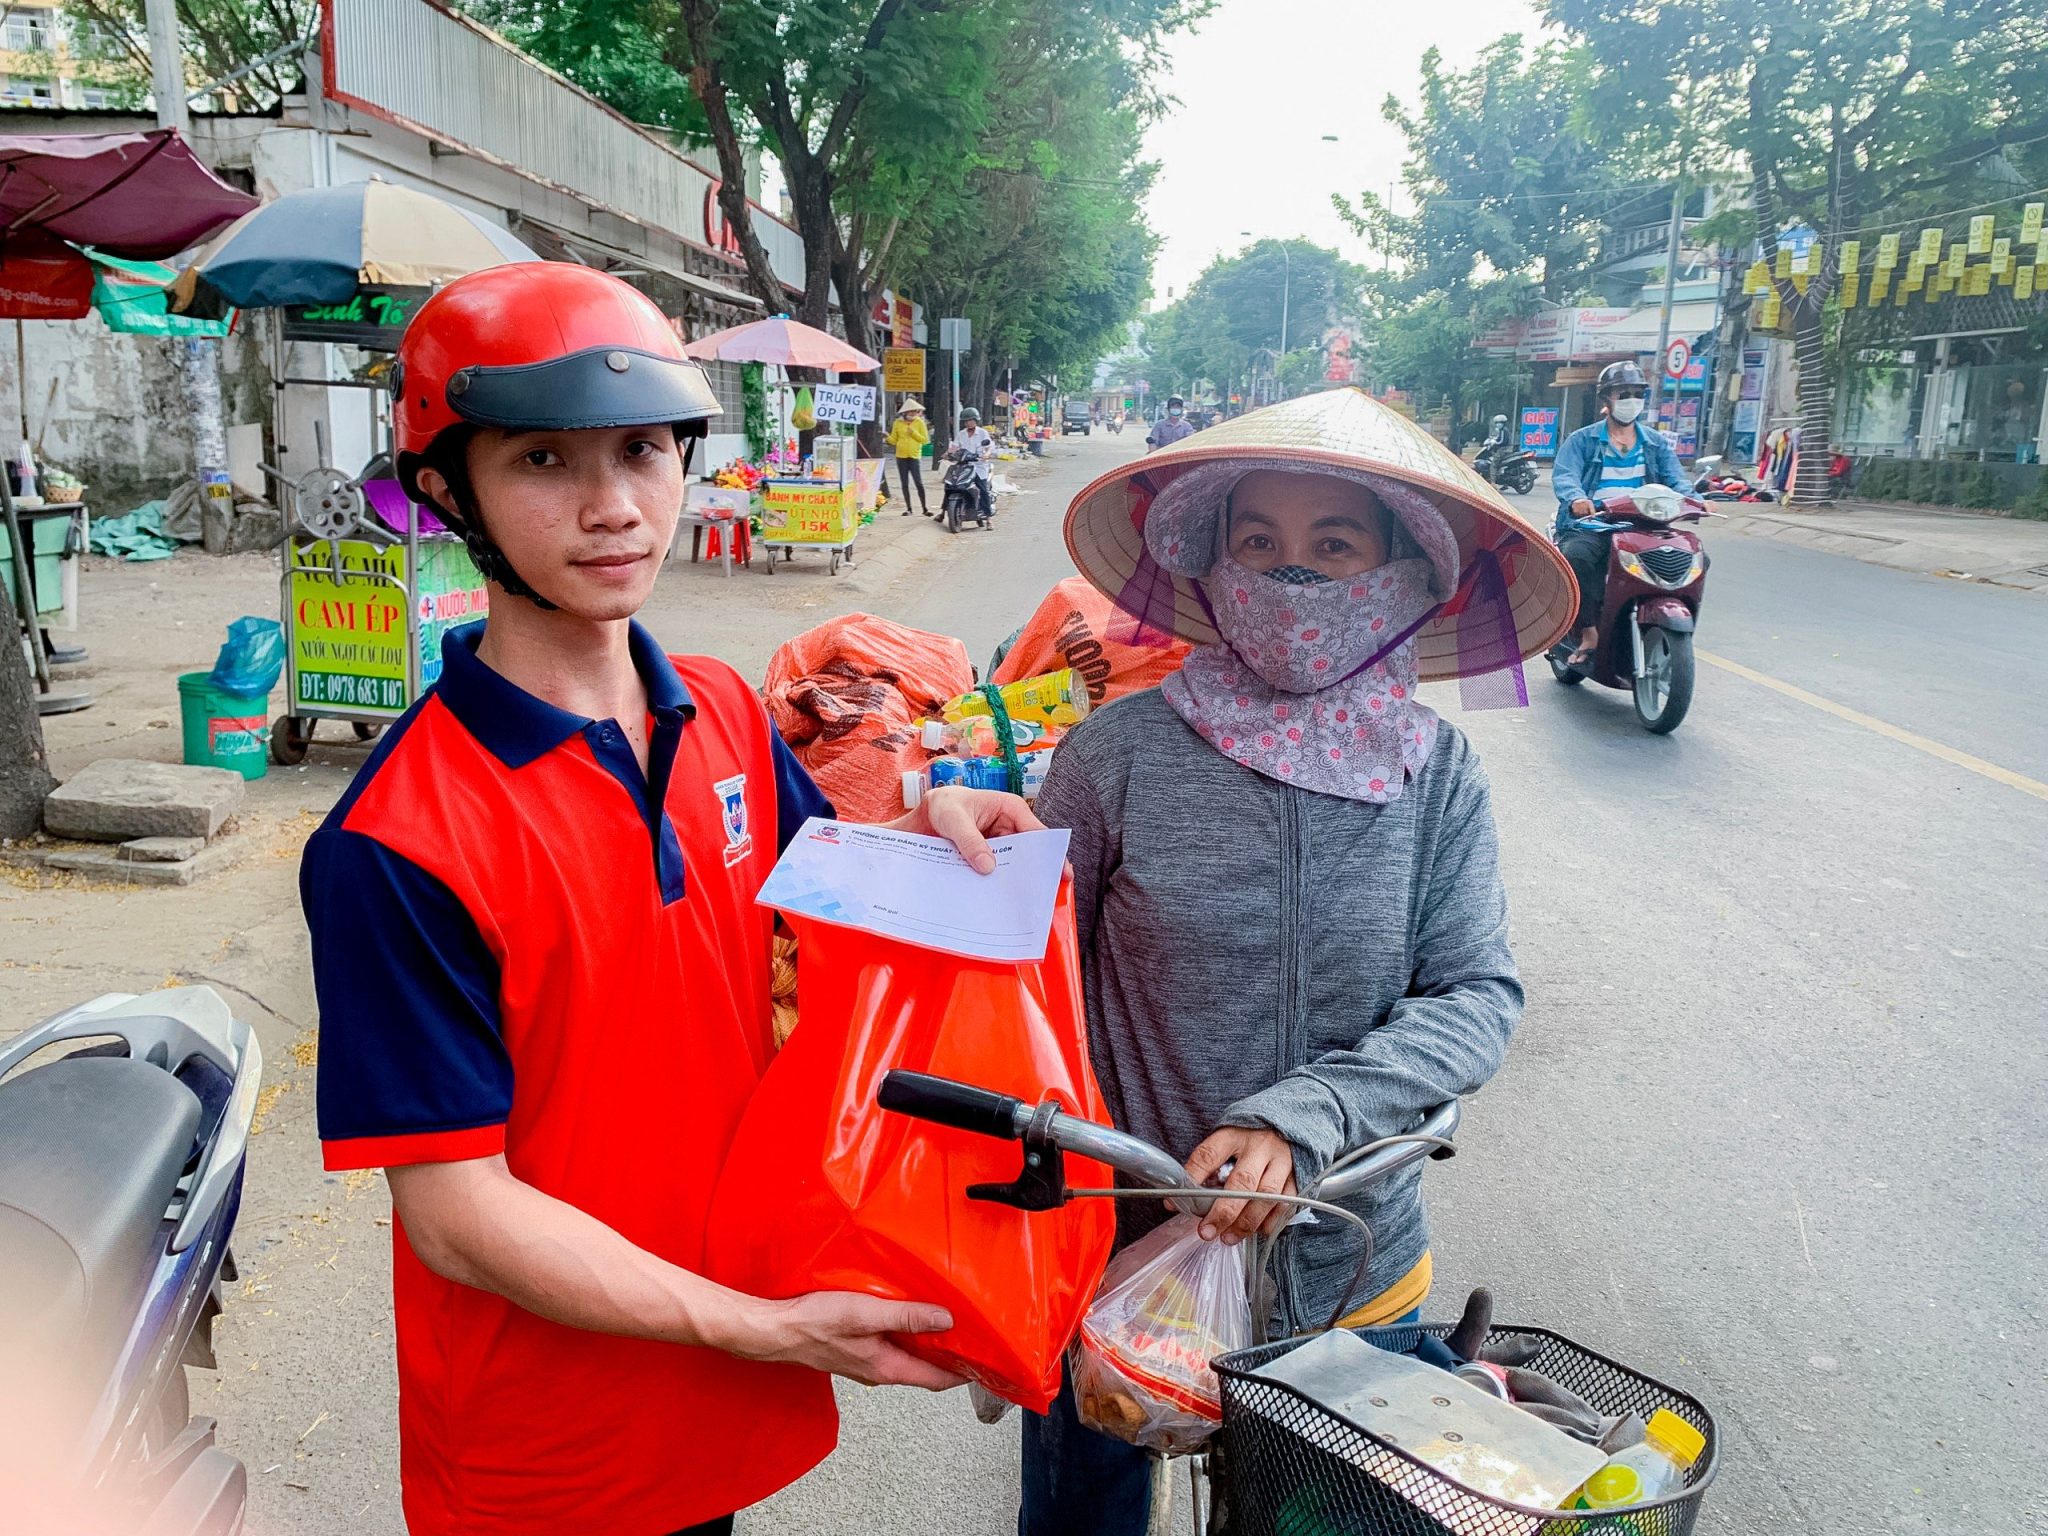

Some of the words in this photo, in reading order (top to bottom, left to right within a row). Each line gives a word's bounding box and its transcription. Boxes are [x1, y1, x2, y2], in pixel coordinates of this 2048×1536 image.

[841, 409, 857, 422] LA
[800, 520, 830, 532] 15K
[299, 598, 355, 631] CAM
[366, 594, 399, 633] ÉP
[301, 673, 325, 700] ĐT:
[327, 674, 356, 703] 0978
[357, 677, 379, 705] 683
[381, 679, 403, 706] 107
[881, 834, 897, 843] CAO
